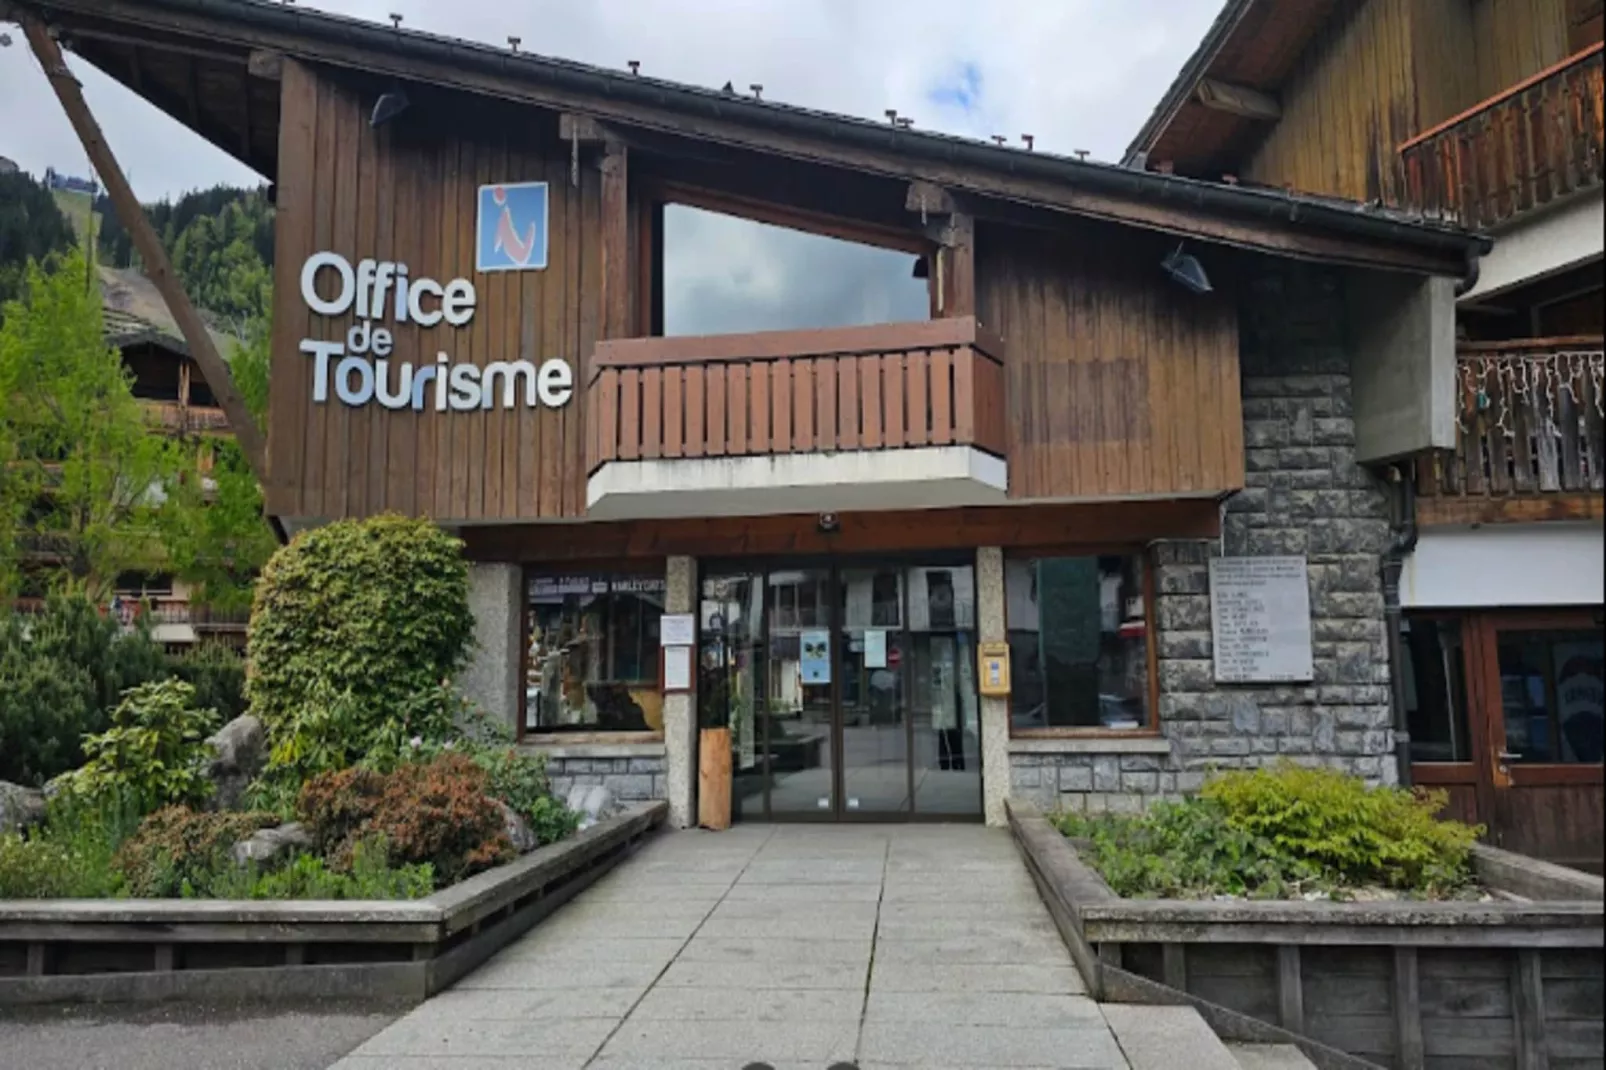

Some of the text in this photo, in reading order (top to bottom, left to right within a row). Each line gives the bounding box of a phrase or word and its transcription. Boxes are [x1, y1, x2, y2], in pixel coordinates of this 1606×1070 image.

[300, 251, 476, 326] Office
[300, 338, 573, 412] Tourisme
[347, 320, 393, 356] de
